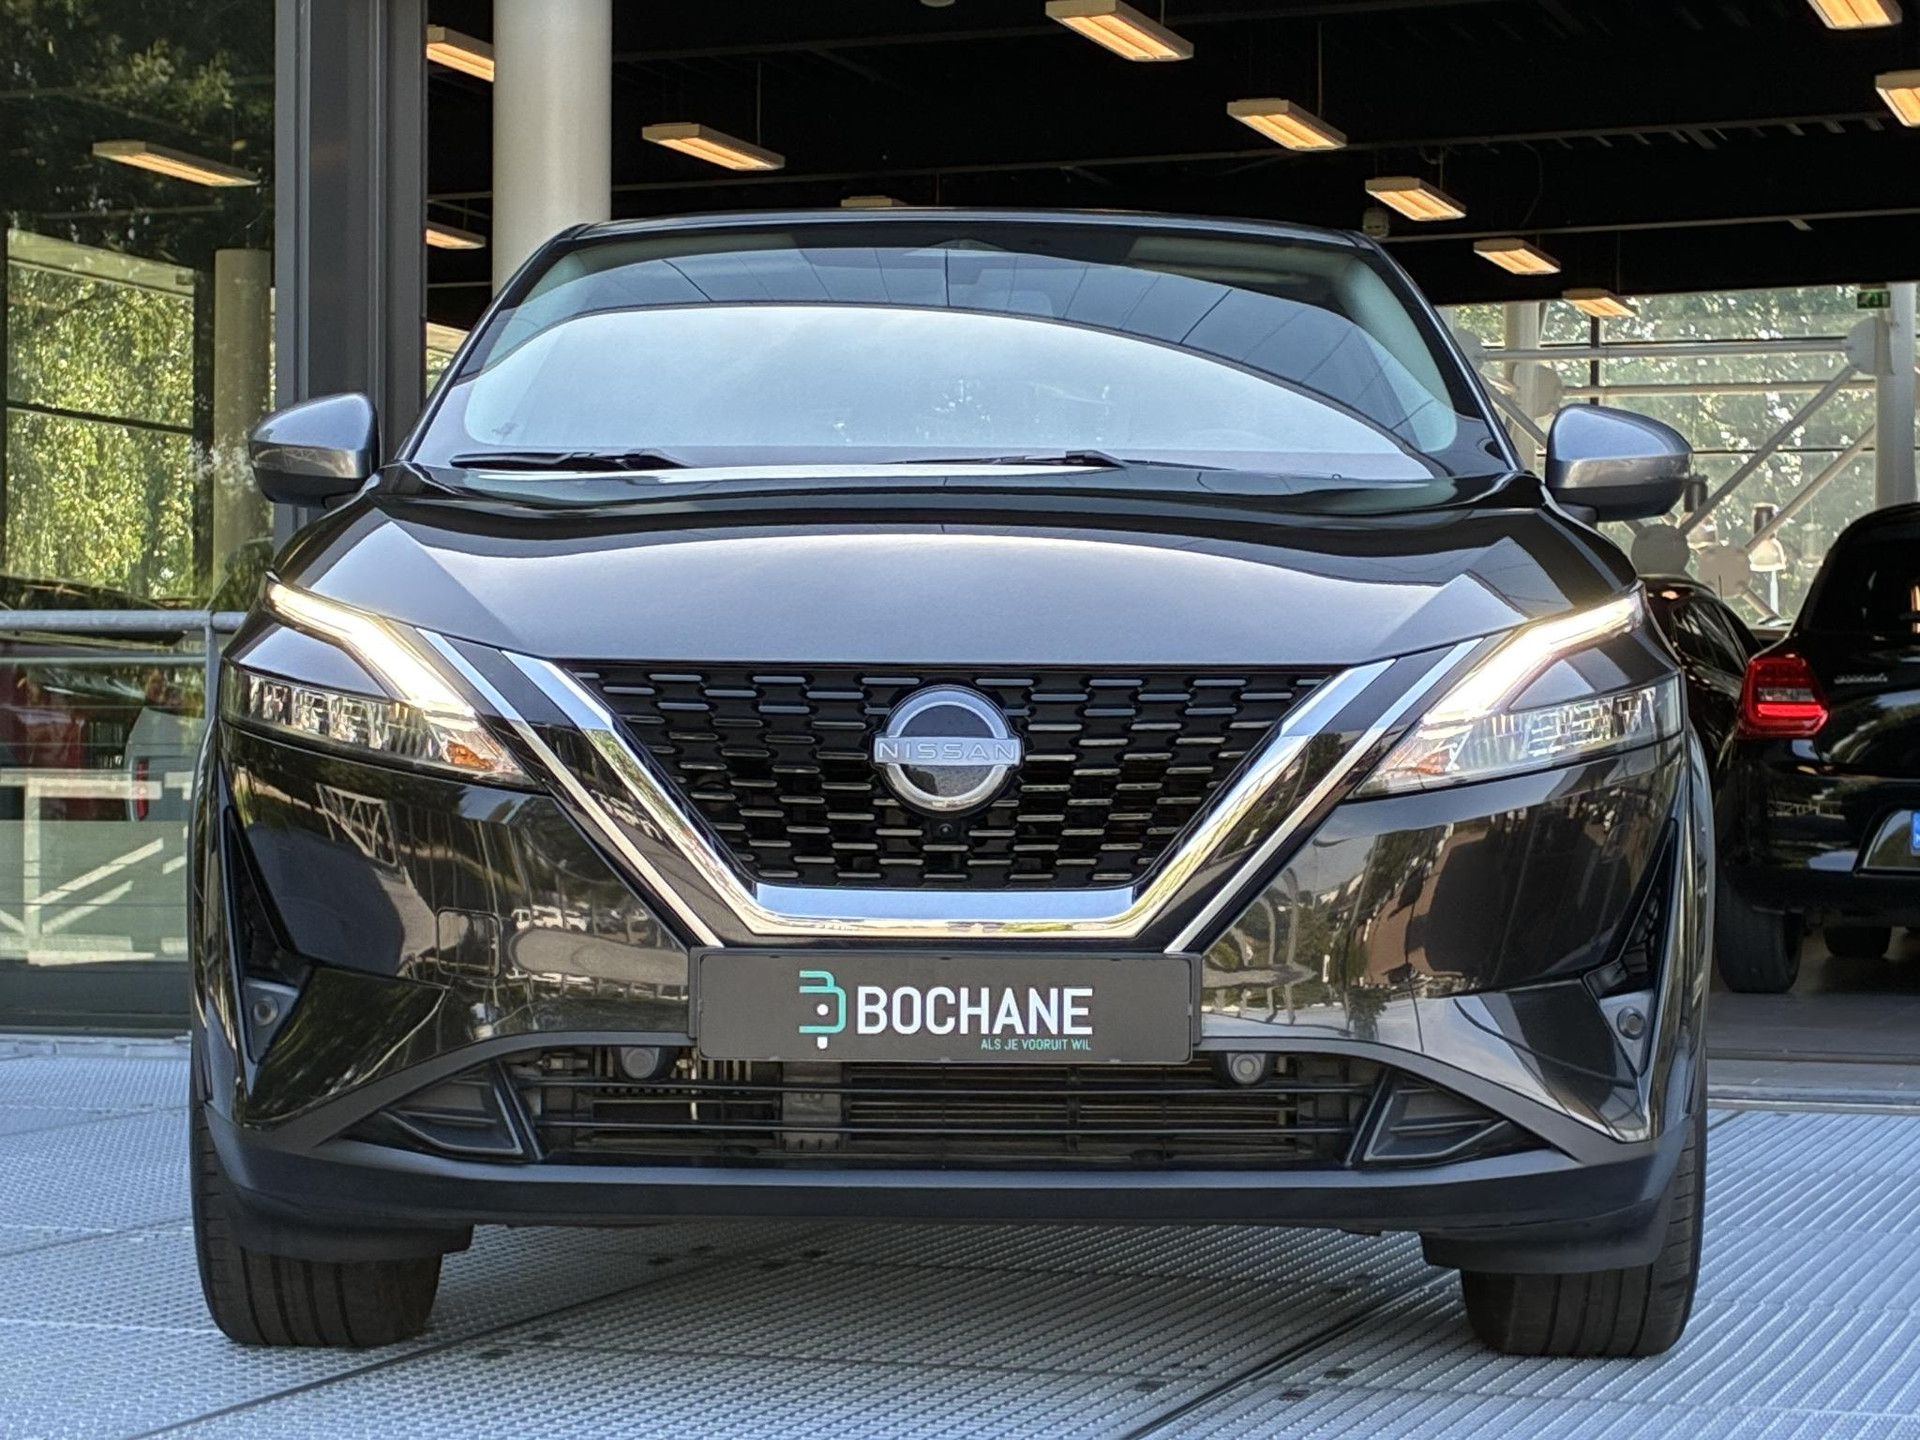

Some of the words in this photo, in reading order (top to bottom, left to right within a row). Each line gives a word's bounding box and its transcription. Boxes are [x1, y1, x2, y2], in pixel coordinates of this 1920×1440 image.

[878, 742, 1016, 761] NISSAN
[857, 986, 1093, 1035] BOCHANE
[981, 1038, 1001, 1051] ALS
[1004, 1038, 1019, 1051] JE
[1021, 1038, 1069, 1051] VOORUIT
[1071, 1038, 1092, 1051] WIL
